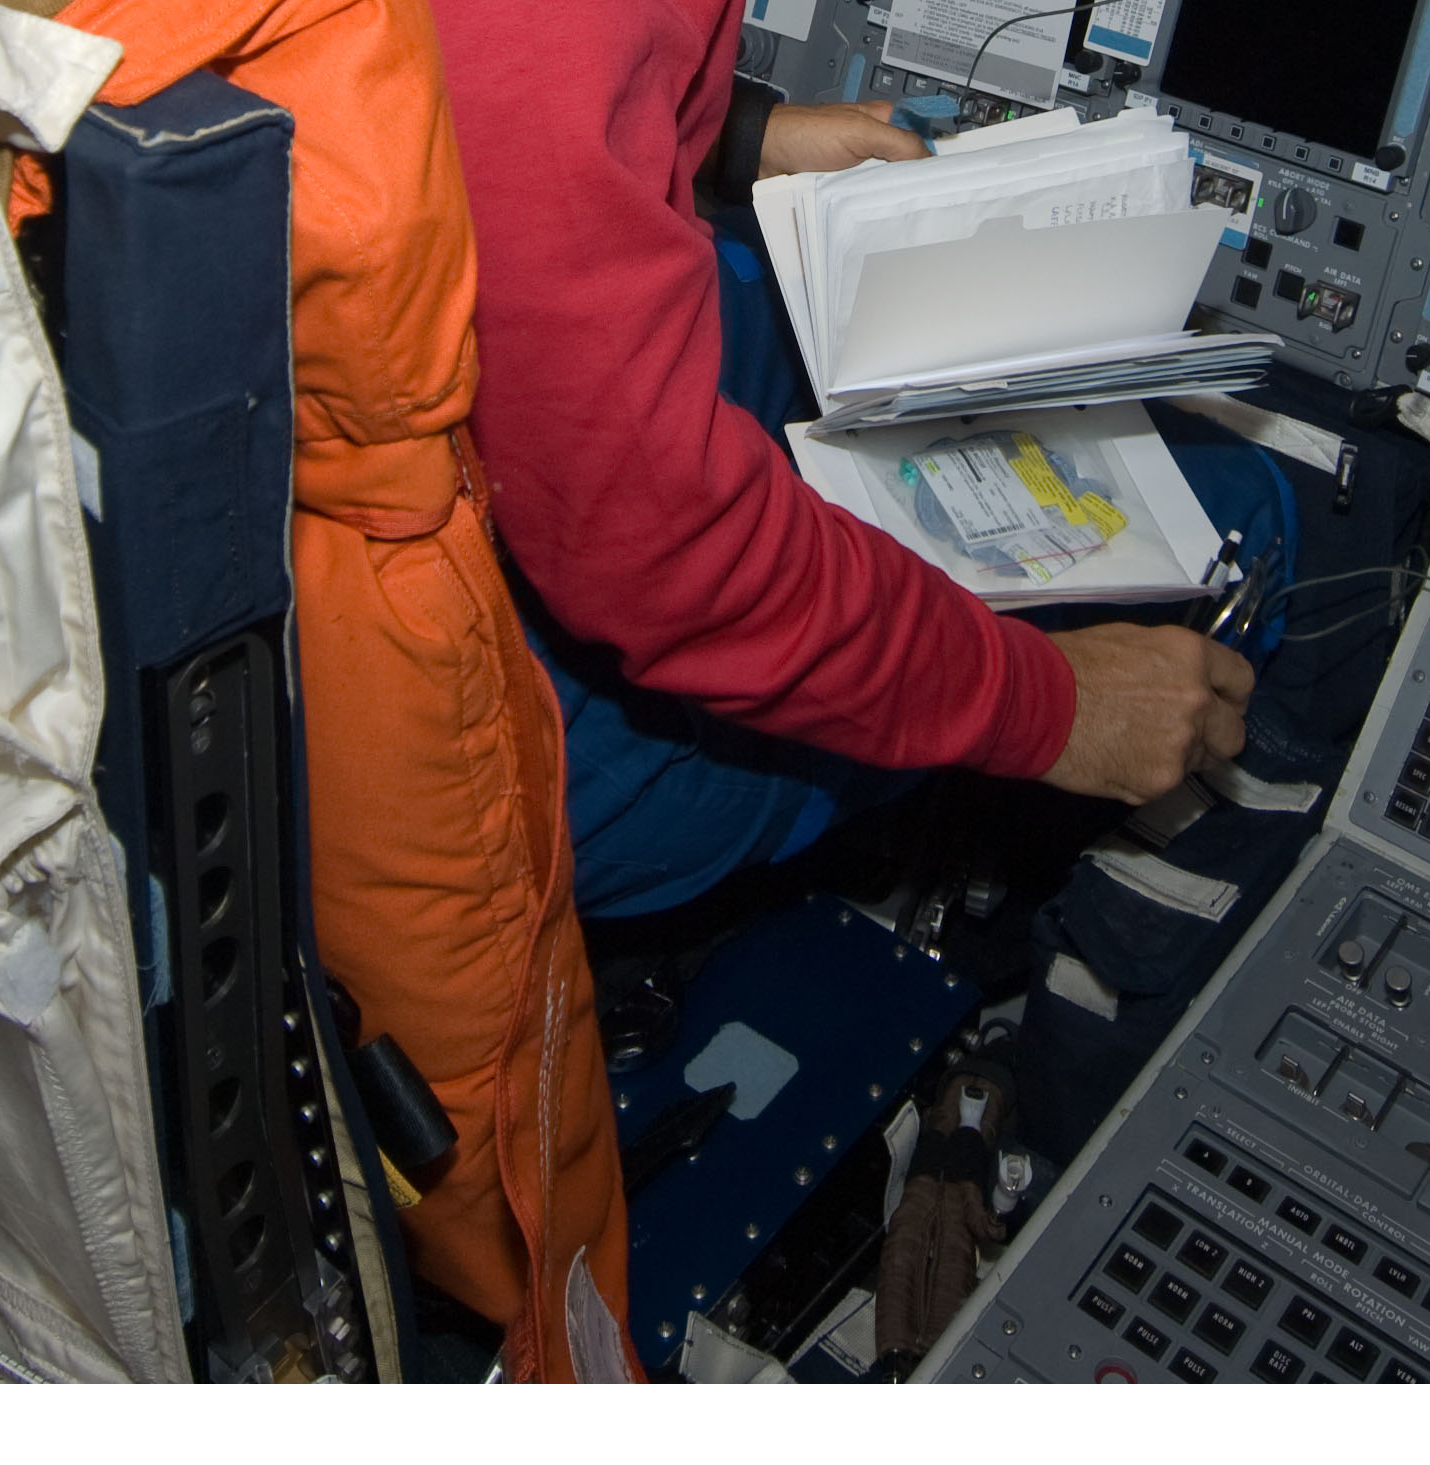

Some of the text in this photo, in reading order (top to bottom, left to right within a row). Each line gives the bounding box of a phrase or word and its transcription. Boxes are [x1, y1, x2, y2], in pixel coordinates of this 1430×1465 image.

[1279, 167, 1331, 191] ABORT MODE
[1324, 266, 1361, 286] AIR DATA
[1397, 877, 1420, 896] OMS
[1329, 999, 1385, 1034] PROBE STOW
[1337, 994, 1387, 1027] AIR DATA
[1362, 1211, 1407, 1243] CONTROL
[1186, 1181, 1406, 1328] TRANSLATION ROTATION
[1257, 1216, 1350, 1279] MANUAL MODE
[1355, 1301, 1384, 1325] PITCH
[1137, 1326, 1160, 1346] PULSE
